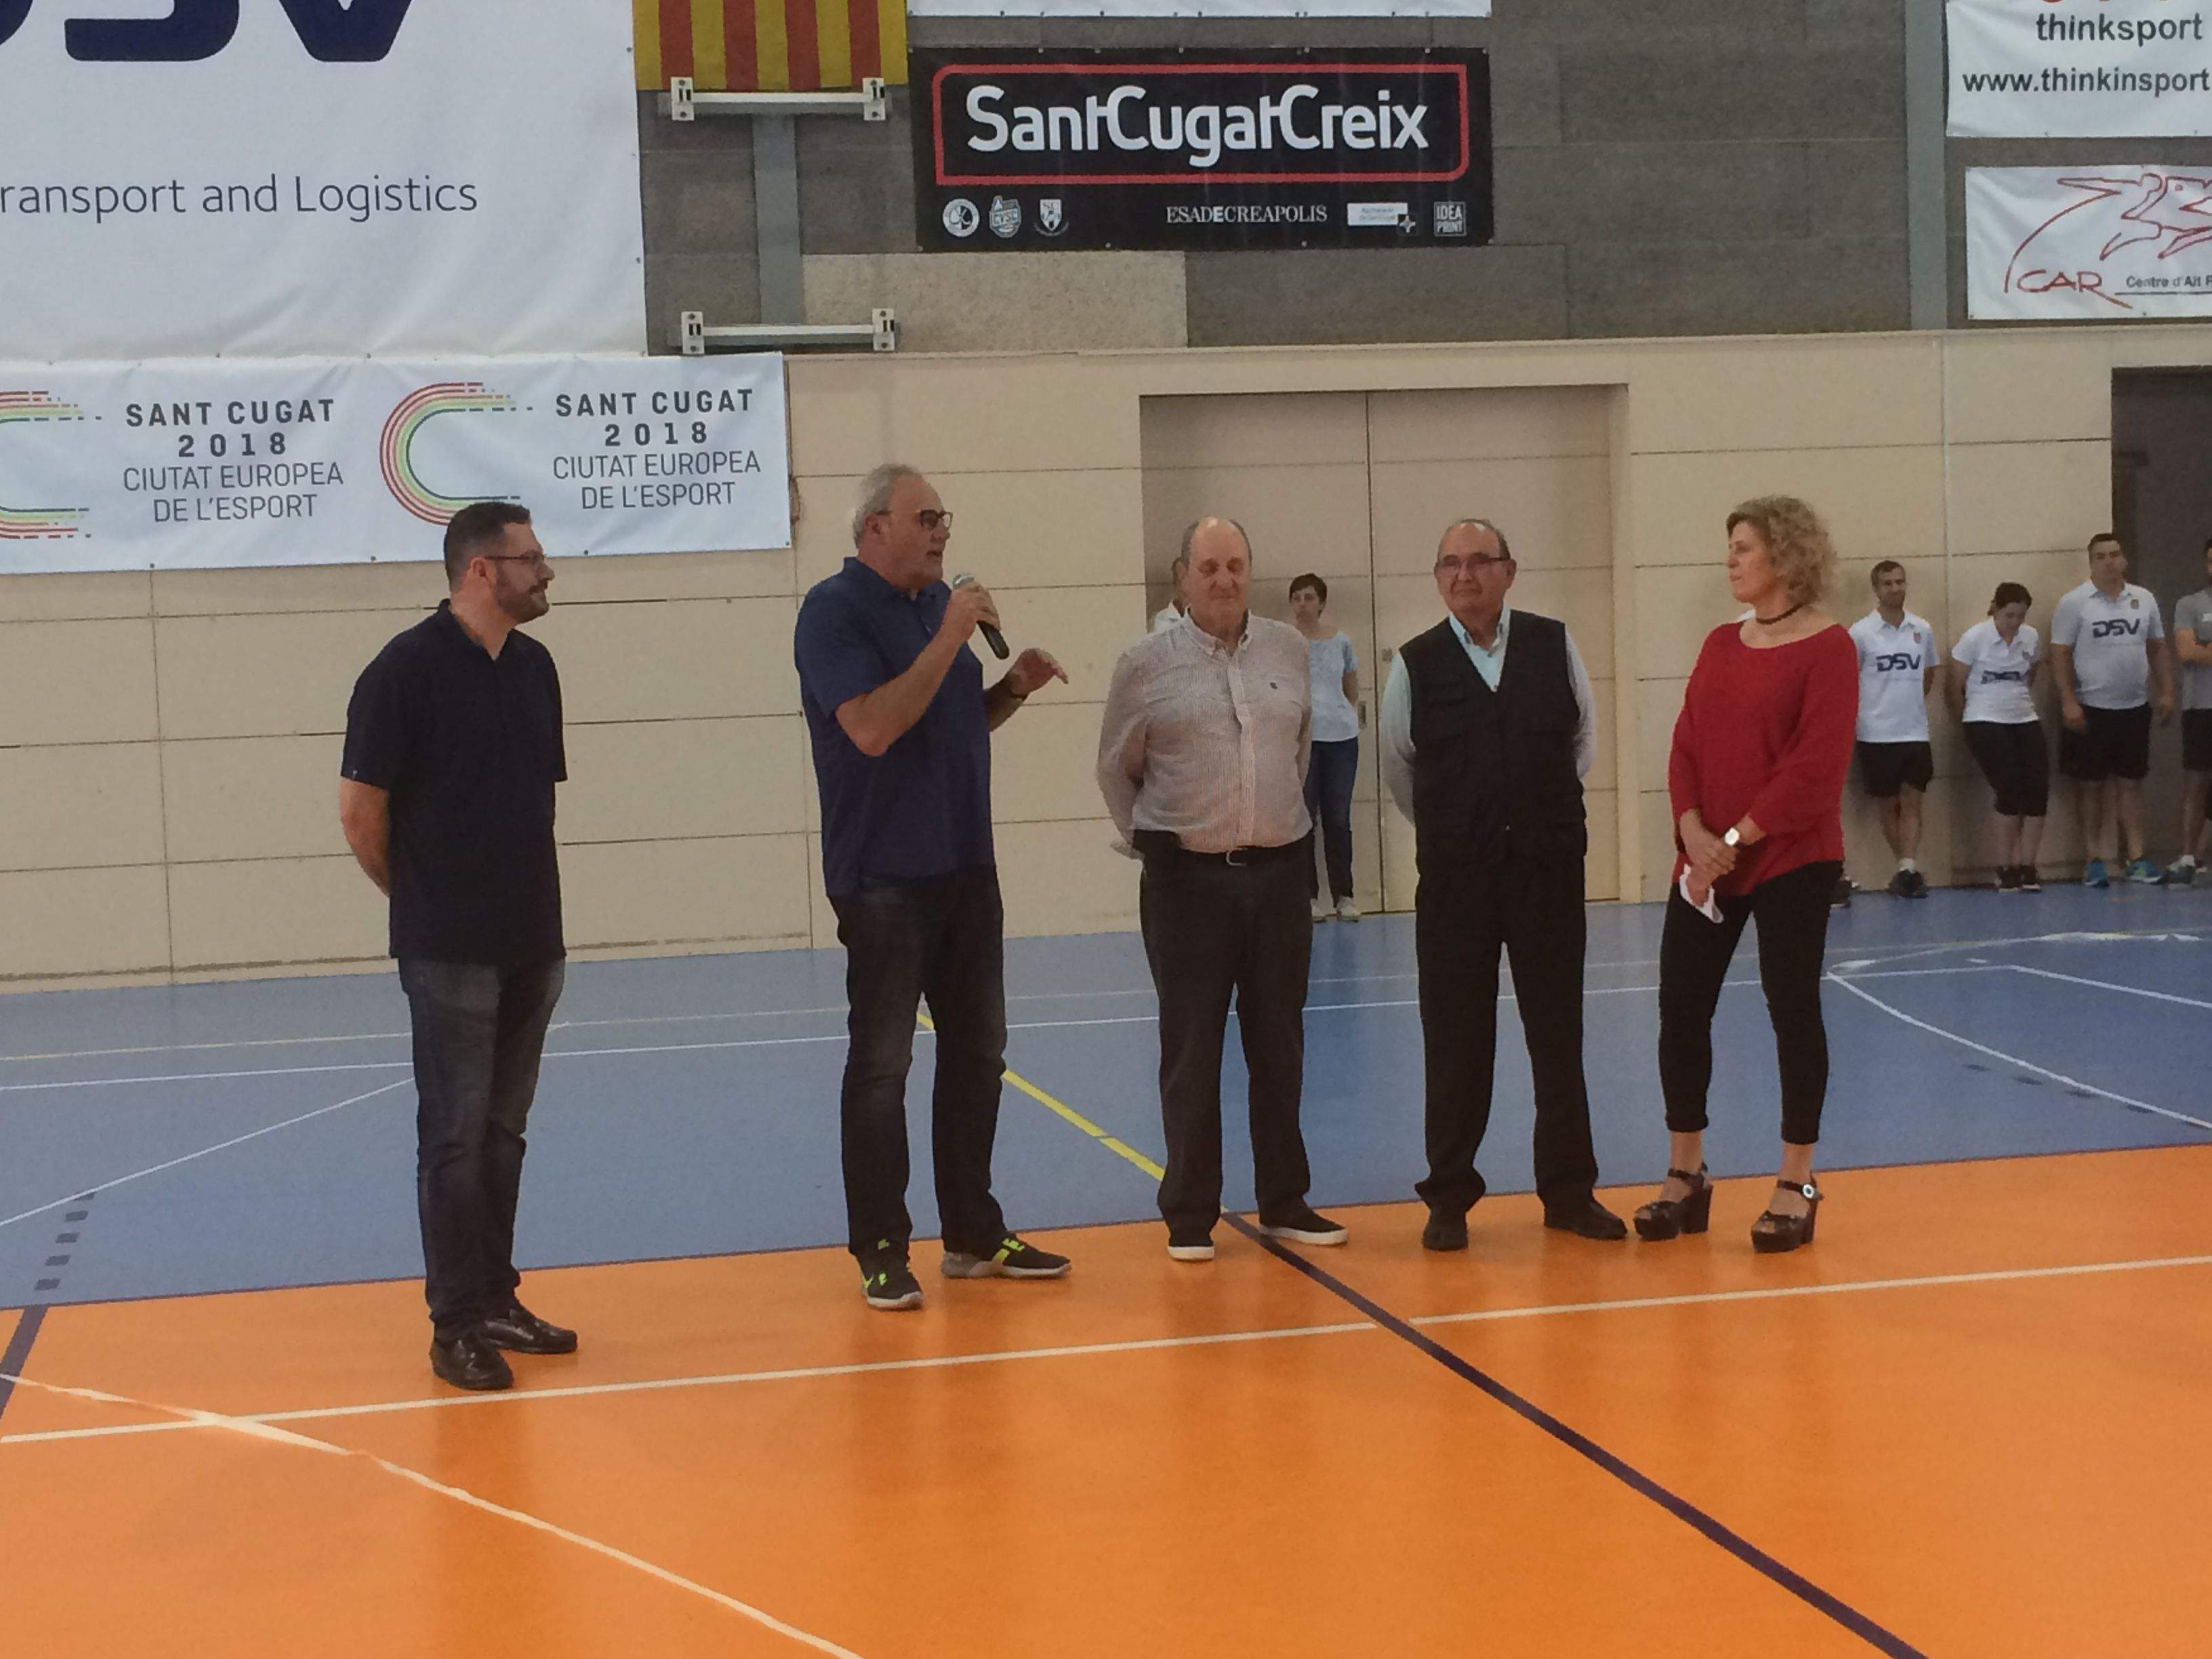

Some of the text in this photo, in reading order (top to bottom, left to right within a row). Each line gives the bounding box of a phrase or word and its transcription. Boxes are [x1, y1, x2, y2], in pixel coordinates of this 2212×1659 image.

[2036, 13, 2203, 47] thinksport
[1963, 67, 2211, 97] www.thinkinsport
[966, 83, 1429, 167] SantCugatCreix
[0, 174, 478, 224] ransport and Logistics
[1436, 205, 1462, 220] IDEA
[1166, 205, 1328, 223] ESADECREAPOLIS
[126, 398, 333, 427] SANT CUGAT
[556, 388, 752, 417] SANT CUGAT
[178, 432, 286, 457] 2018
[605, 421, 707, 447] 2018
[123, 462, 344, 491] CIUTAT EUROPEA
[553, 450, 761, 479] CIUTAT EUROPEA
[154, 494, 317, 522] DE L'ESPORT
[581, 481, 735, 509] DE L'ESPORT
[2092, 618, 2140, 638] DSV
[1876, 653, 1921, 672] DSV
